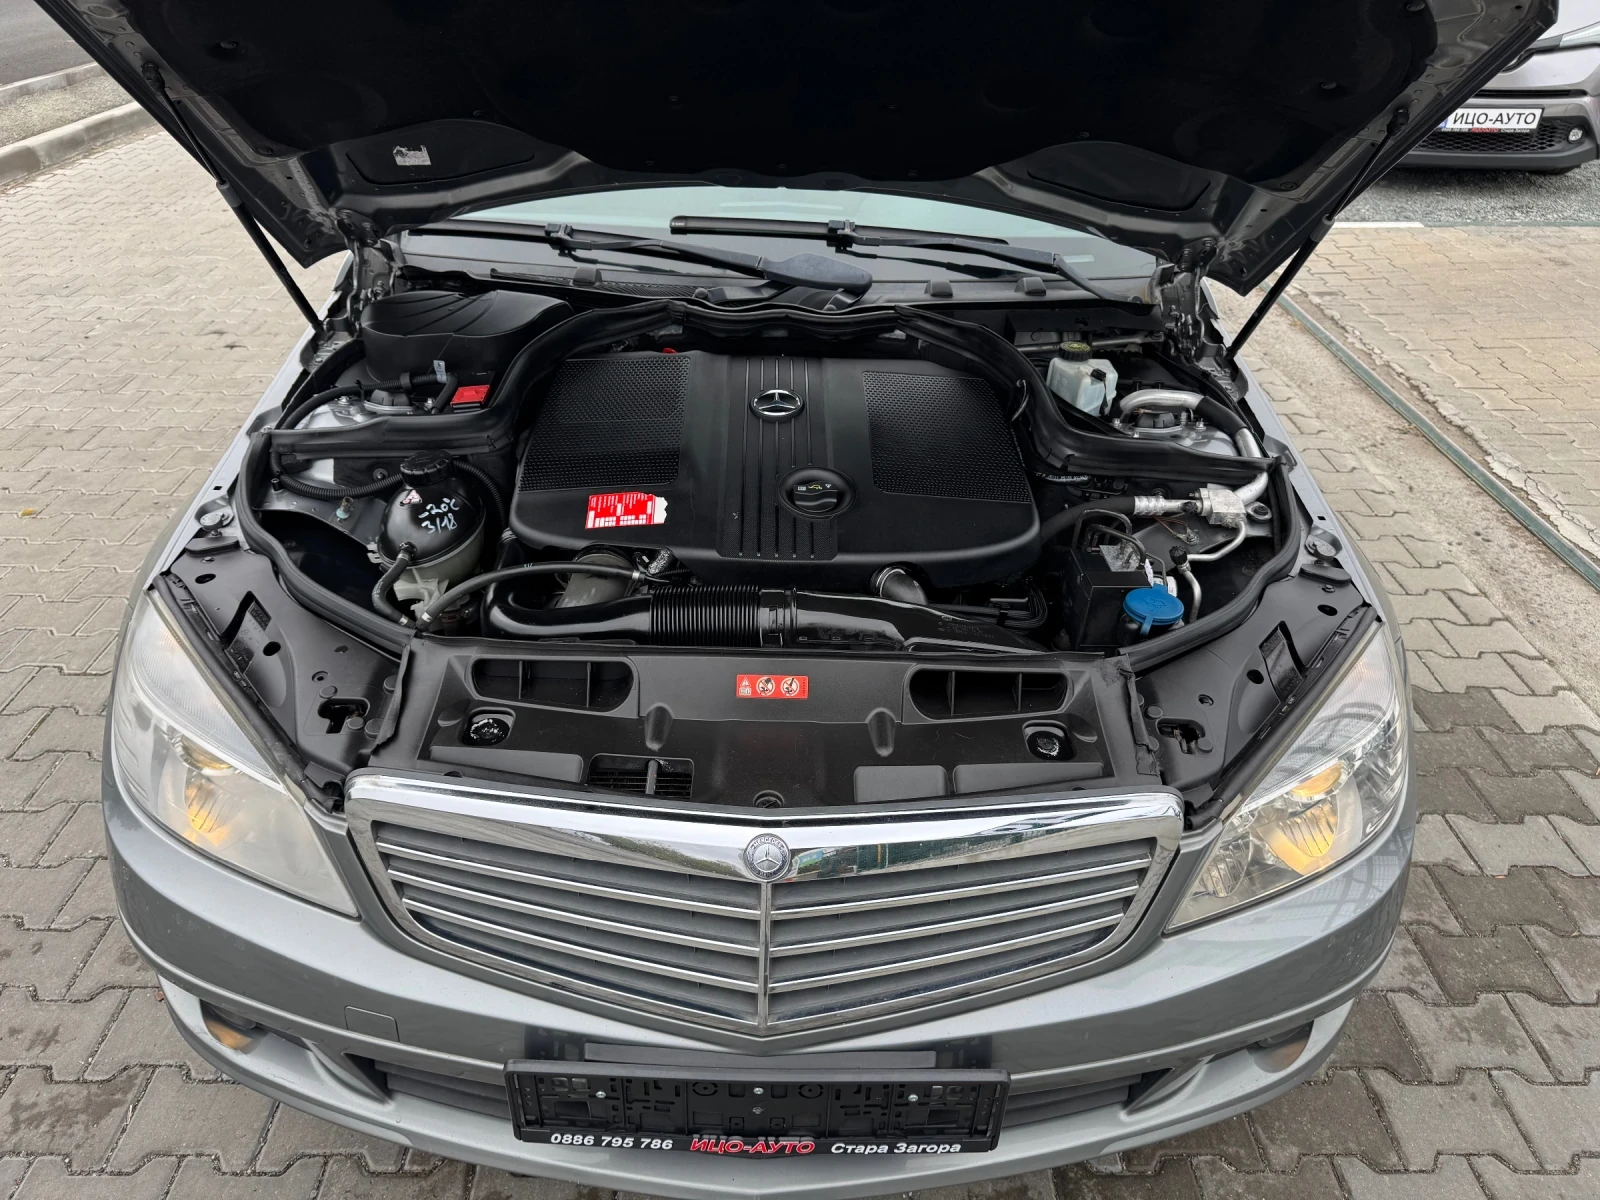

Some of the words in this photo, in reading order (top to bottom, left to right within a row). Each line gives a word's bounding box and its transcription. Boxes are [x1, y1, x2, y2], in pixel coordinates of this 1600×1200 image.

[1453, 112, 1536, 126] ИЦО-АУТО
[550, 1133, 595, 1146] 0886
[601, 1136, 635, 1148] 795
[640, 1138, 674, 1150] 786
[690, 1137, 815, 1154] ИЦО-АУТО
[831, 1142, 888, 1155] Стара
[893, 1142, 962, 1154] Загора
